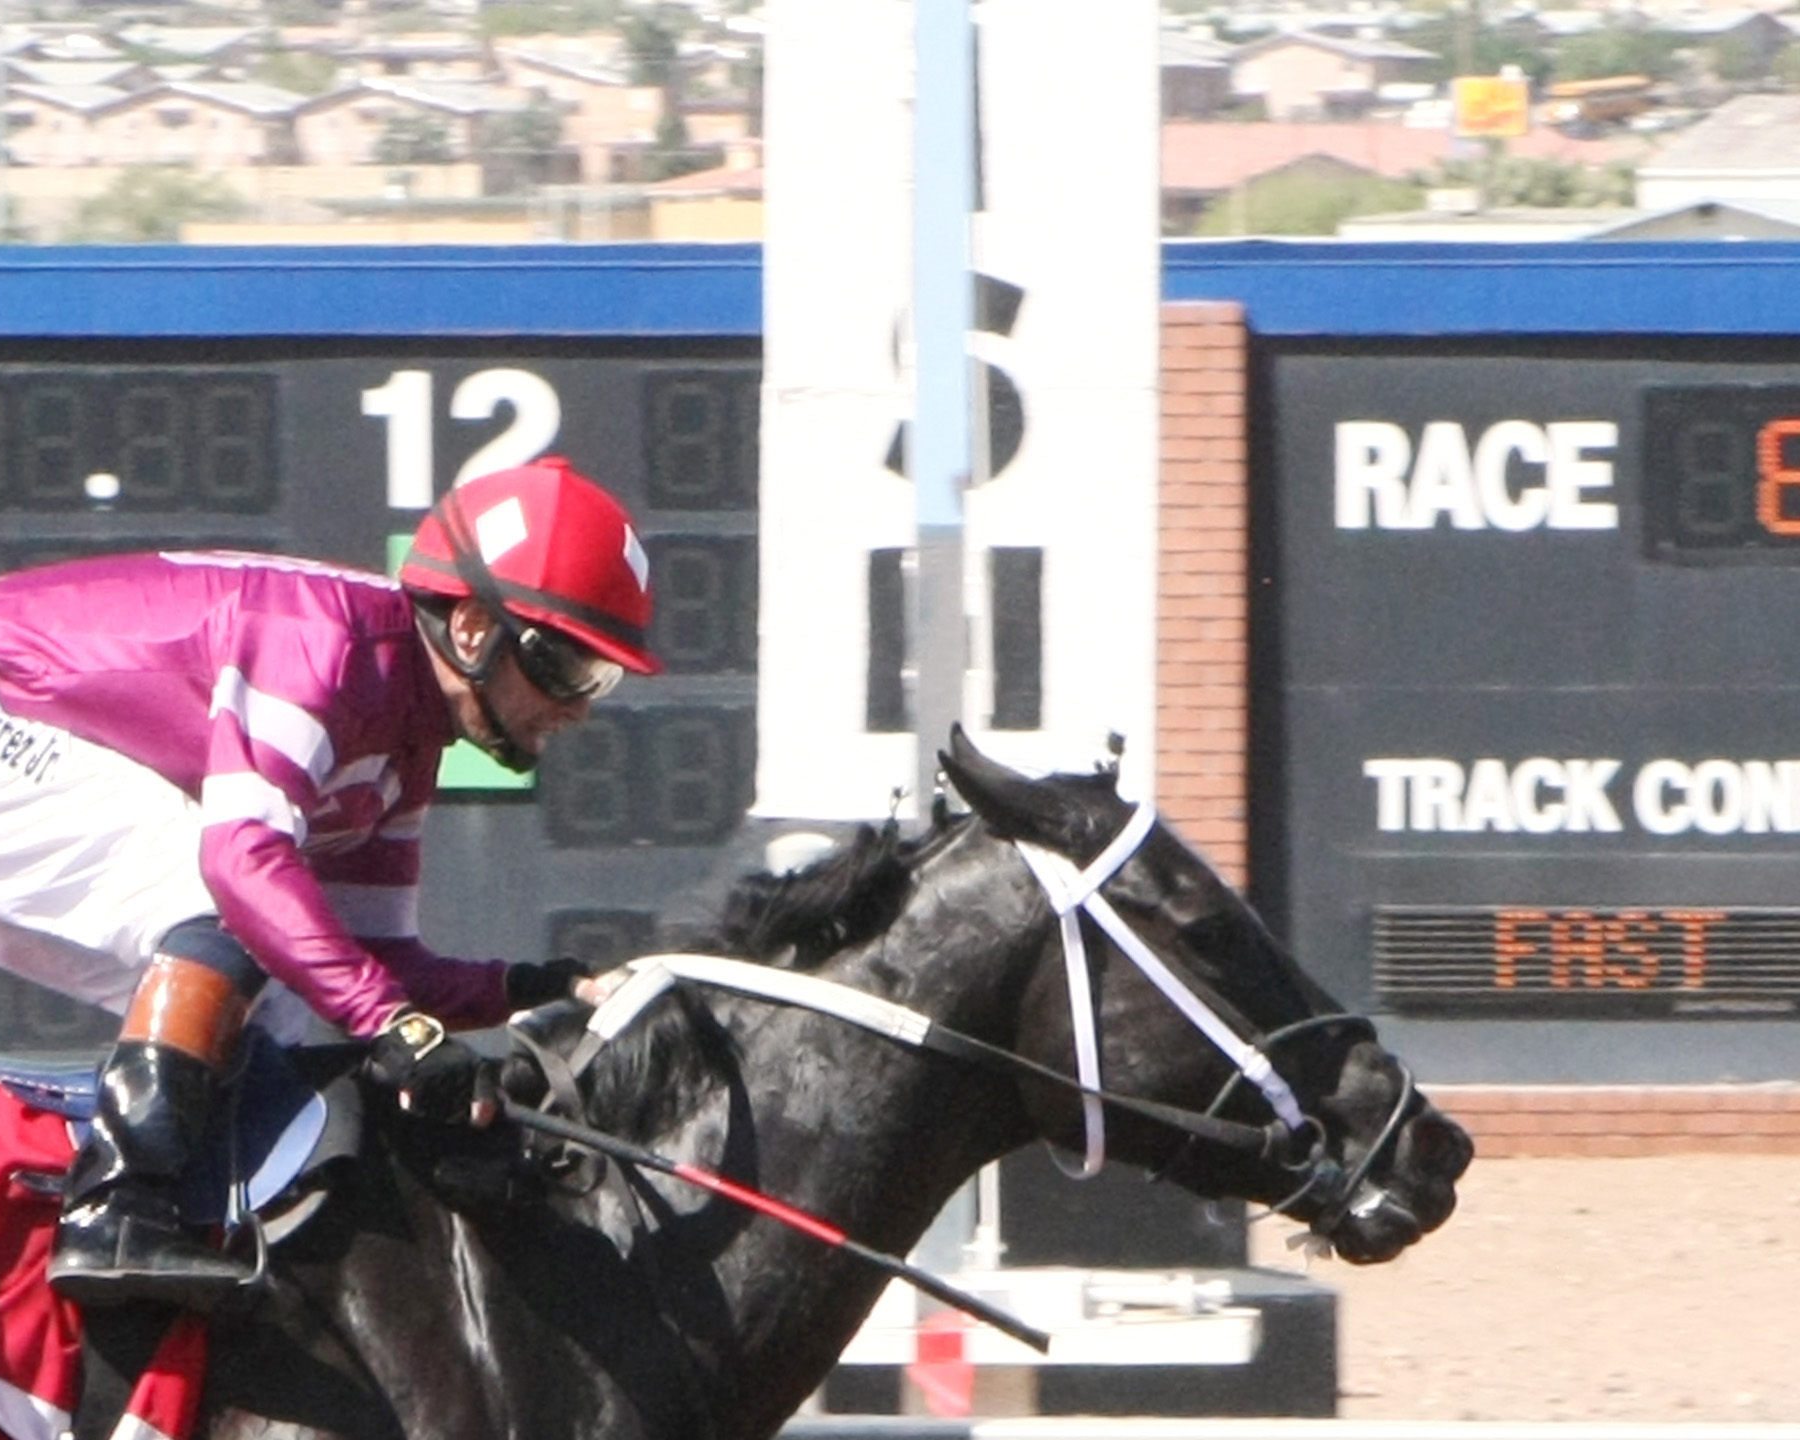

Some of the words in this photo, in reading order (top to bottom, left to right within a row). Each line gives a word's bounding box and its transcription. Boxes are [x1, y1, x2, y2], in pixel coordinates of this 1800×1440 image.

[360, 368, 562, 510] 12
[1334, 419, 1619, 533] RACE
[1363, 757, 1623, 834] TRACK
[1632, 757, 1800, 835] CON
[1493, 909, 1726, 991] FAST
